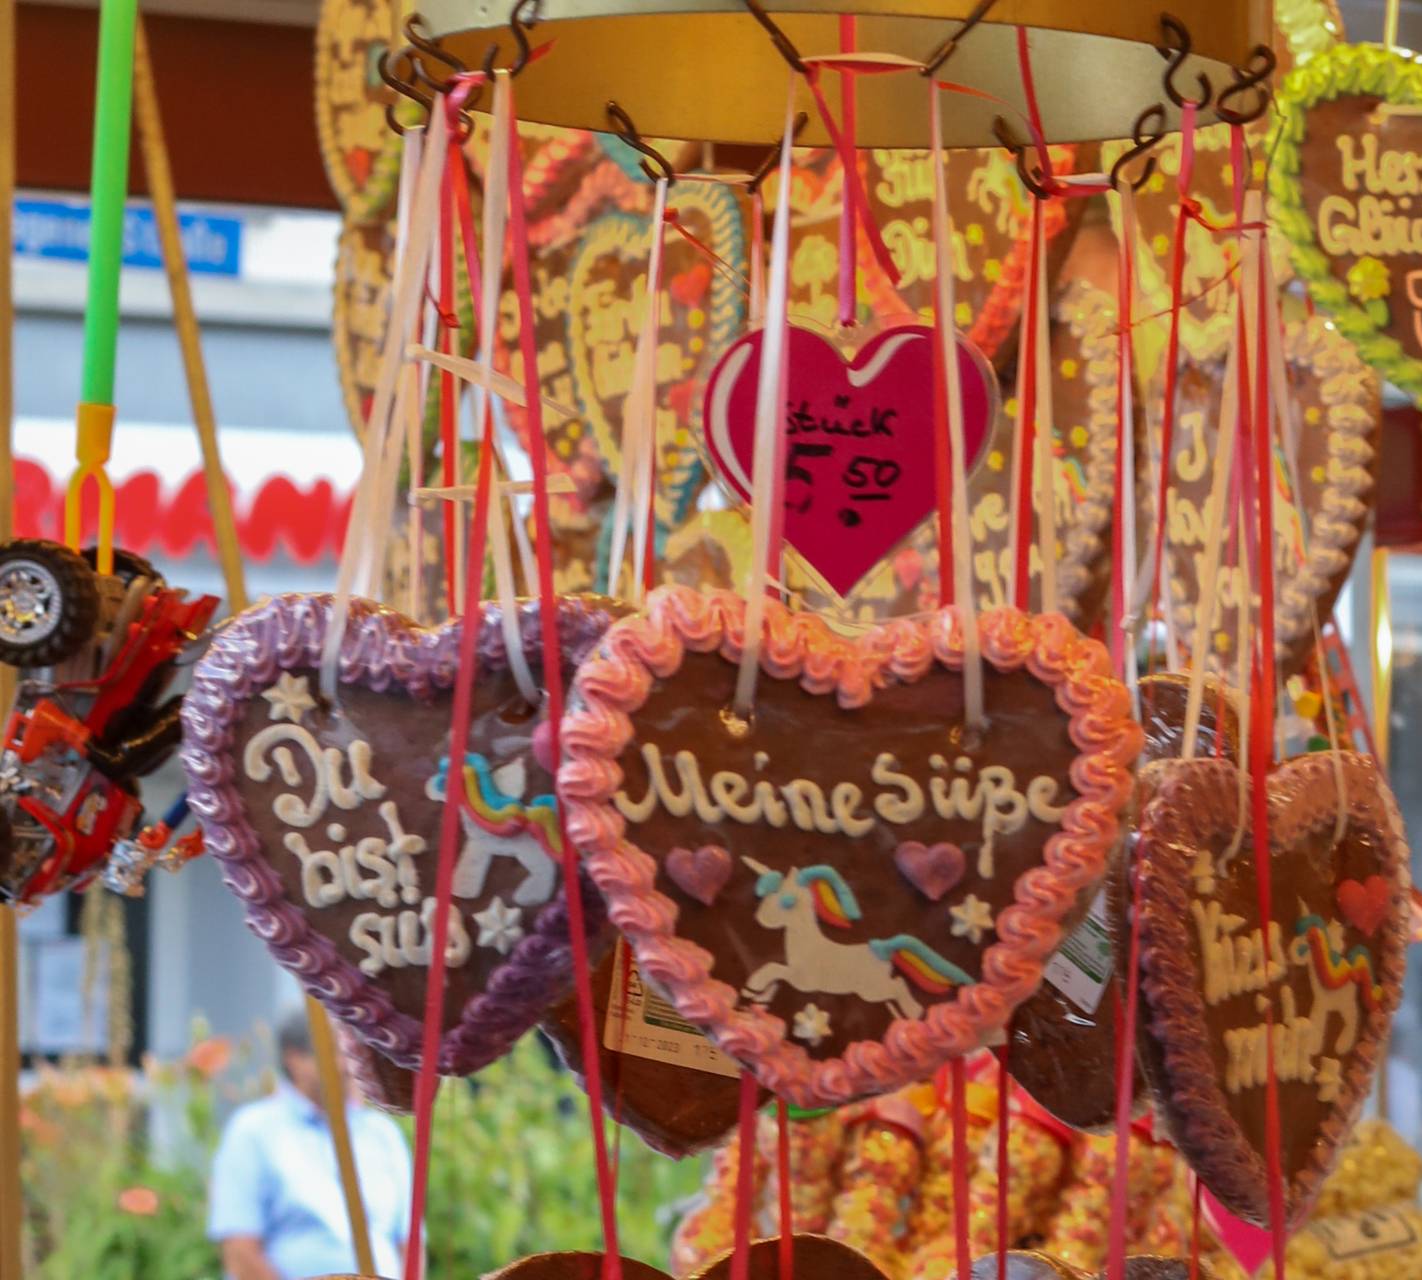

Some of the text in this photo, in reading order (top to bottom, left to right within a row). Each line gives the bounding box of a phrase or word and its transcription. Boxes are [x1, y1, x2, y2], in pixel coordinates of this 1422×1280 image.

[243, 723, 387, 828] Du
[613, 743, 1067, 879] Meine Süße
[283, 800, 427, 908] bist
